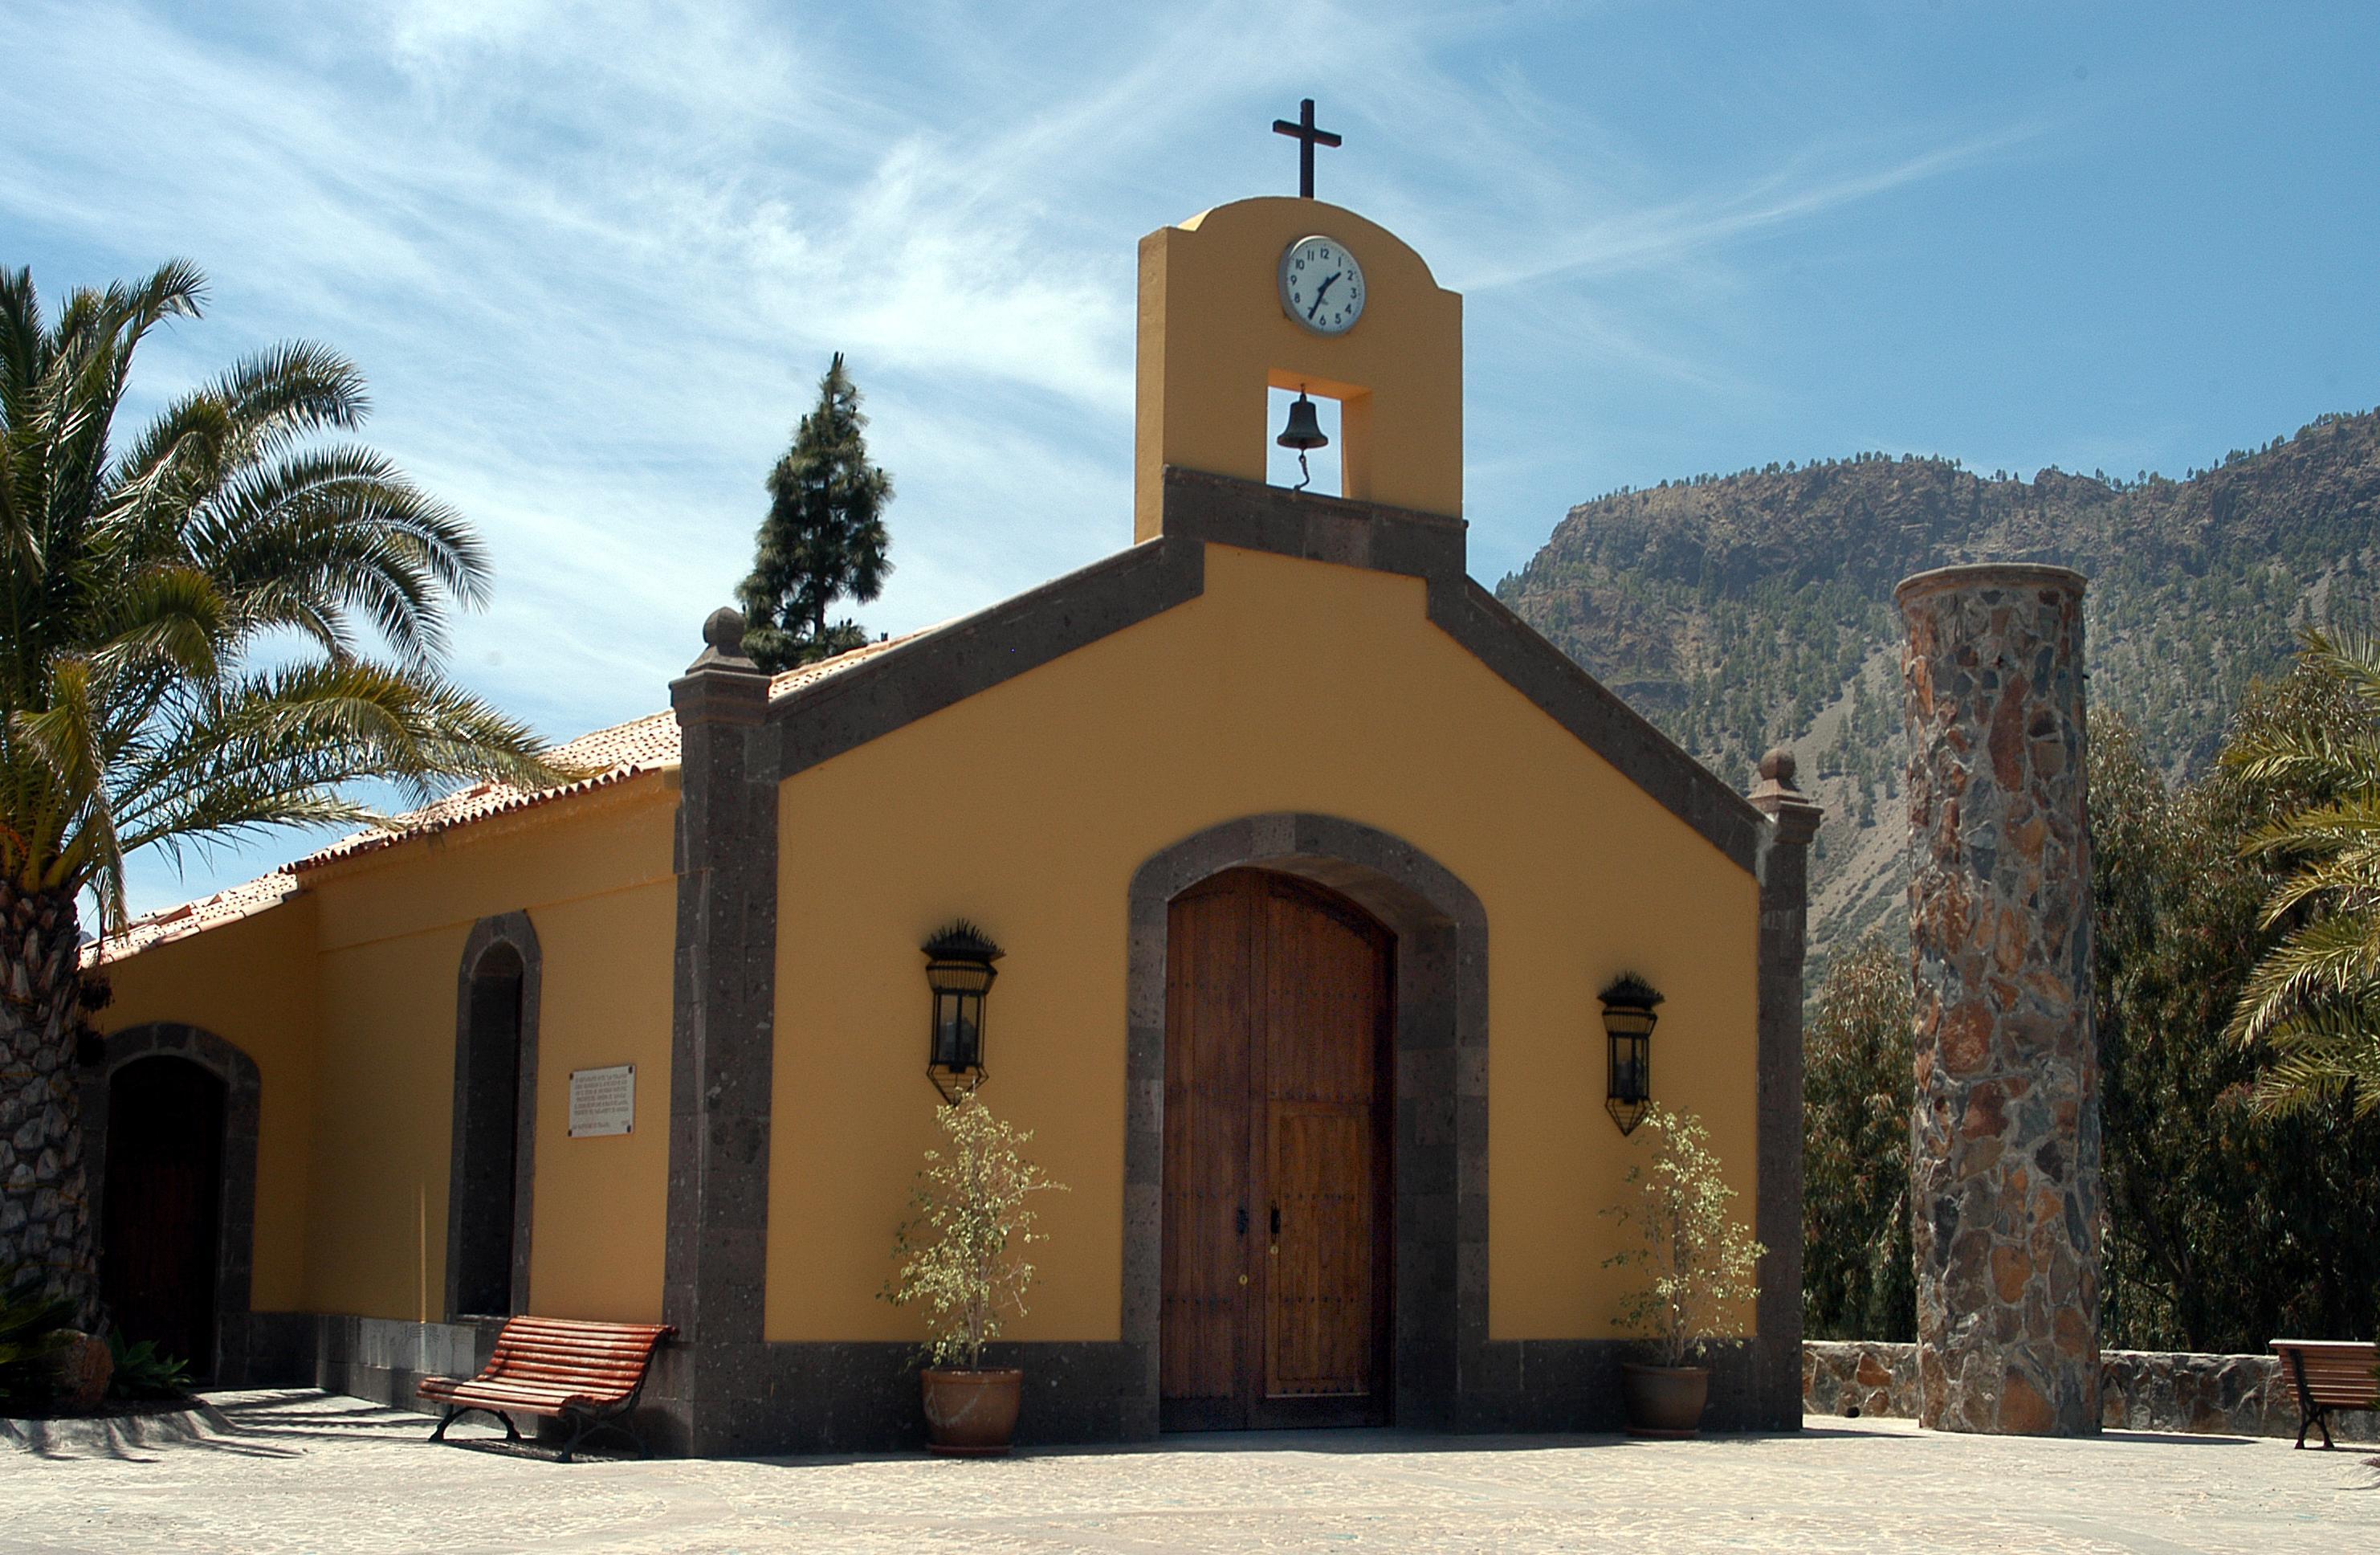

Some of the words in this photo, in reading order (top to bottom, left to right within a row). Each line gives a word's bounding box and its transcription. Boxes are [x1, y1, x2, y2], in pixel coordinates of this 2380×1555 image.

[1307, 251, 1314, 261] 11
[1320, 248, 1329, 259] 12
[1296, 259, 1304, 269] 10
[1291, 275, 1297, 285] 9
[1347, 271, 1354, 280] 2
[1294, 293, 1300, 303] 8
[1351, 288, 1356, 299] 3
[1345, 304, 1351, 314] 4
[1319, 315, 1326, 325] 6
[1335, 314, 1341, 324] 5
